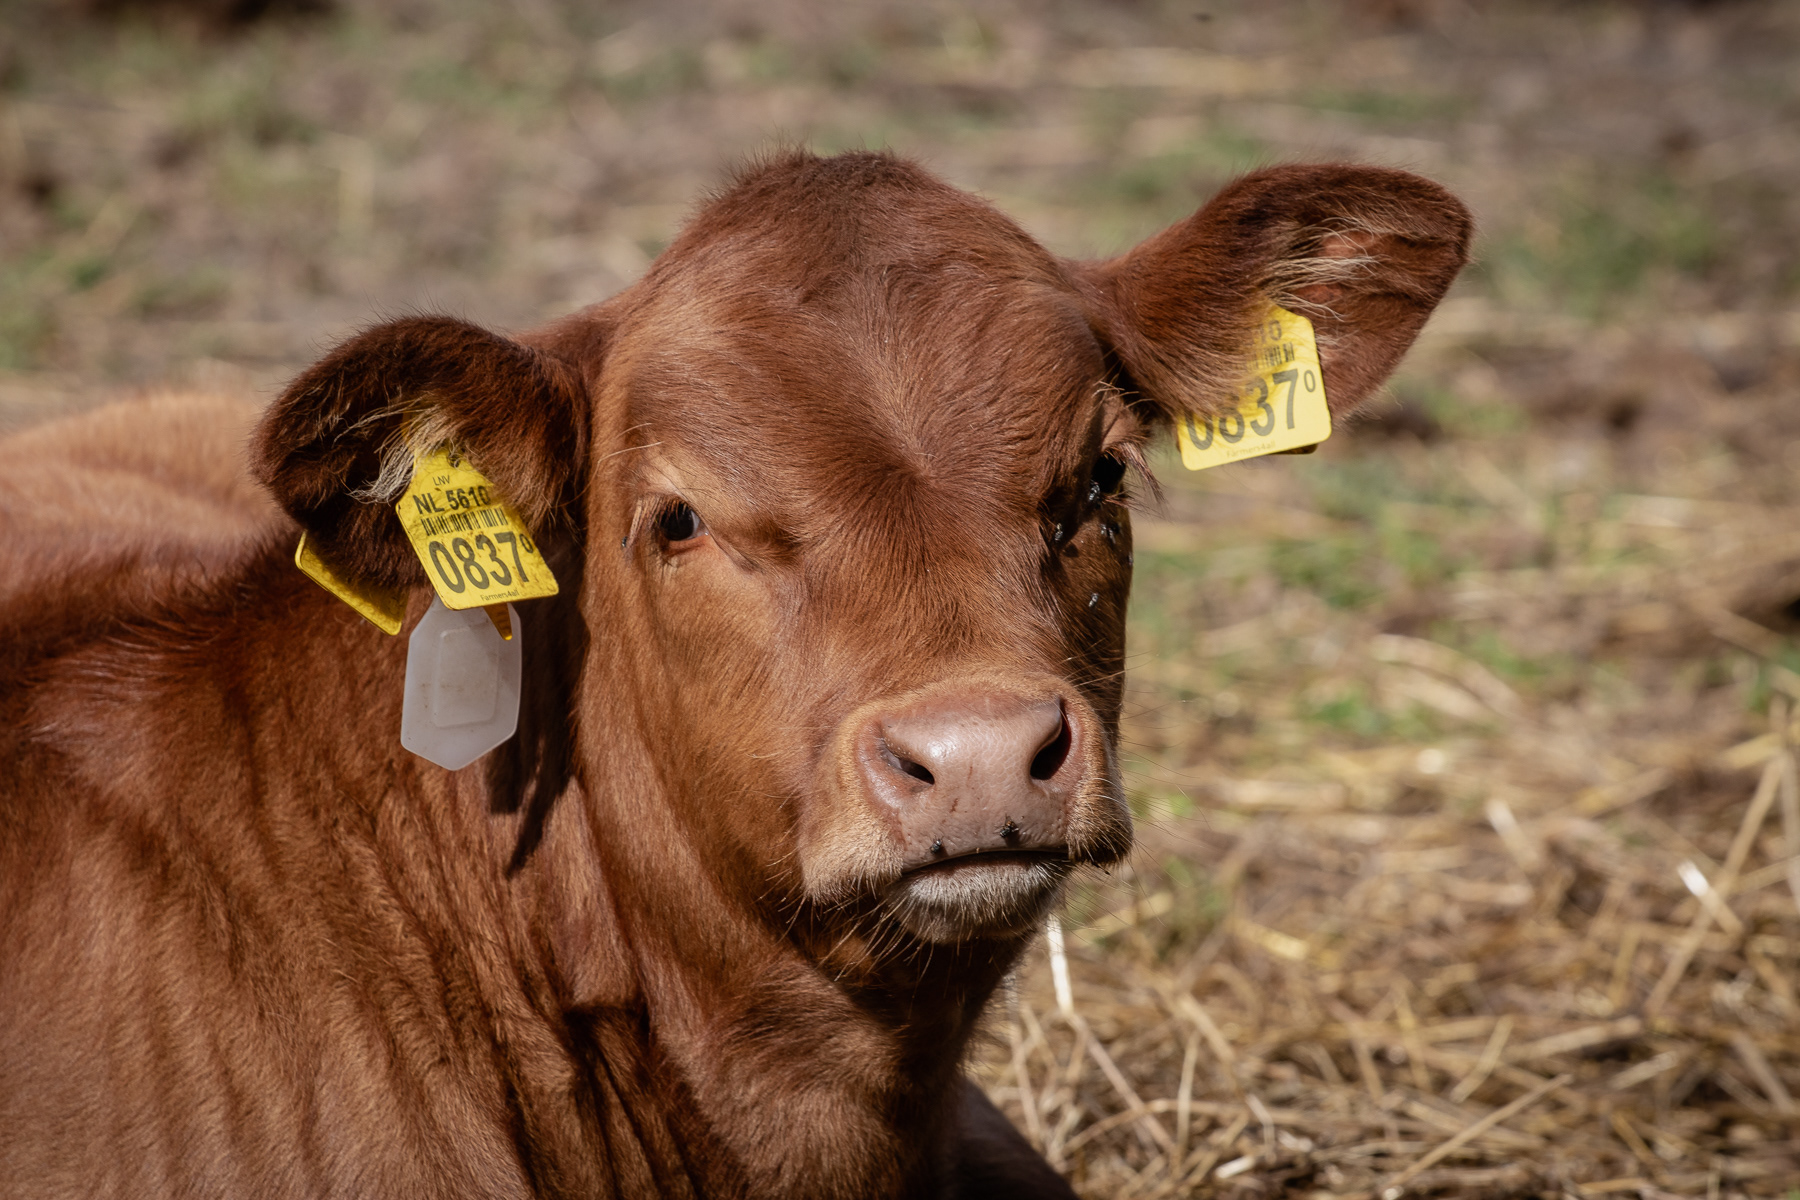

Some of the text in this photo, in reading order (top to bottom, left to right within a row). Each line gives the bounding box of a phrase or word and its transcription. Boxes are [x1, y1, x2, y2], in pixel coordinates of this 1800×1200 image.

[433, 475, 451, 487] LNV
[412, 485, 492, 515] NL 5610
[428, 531, 530, 594] 0837
